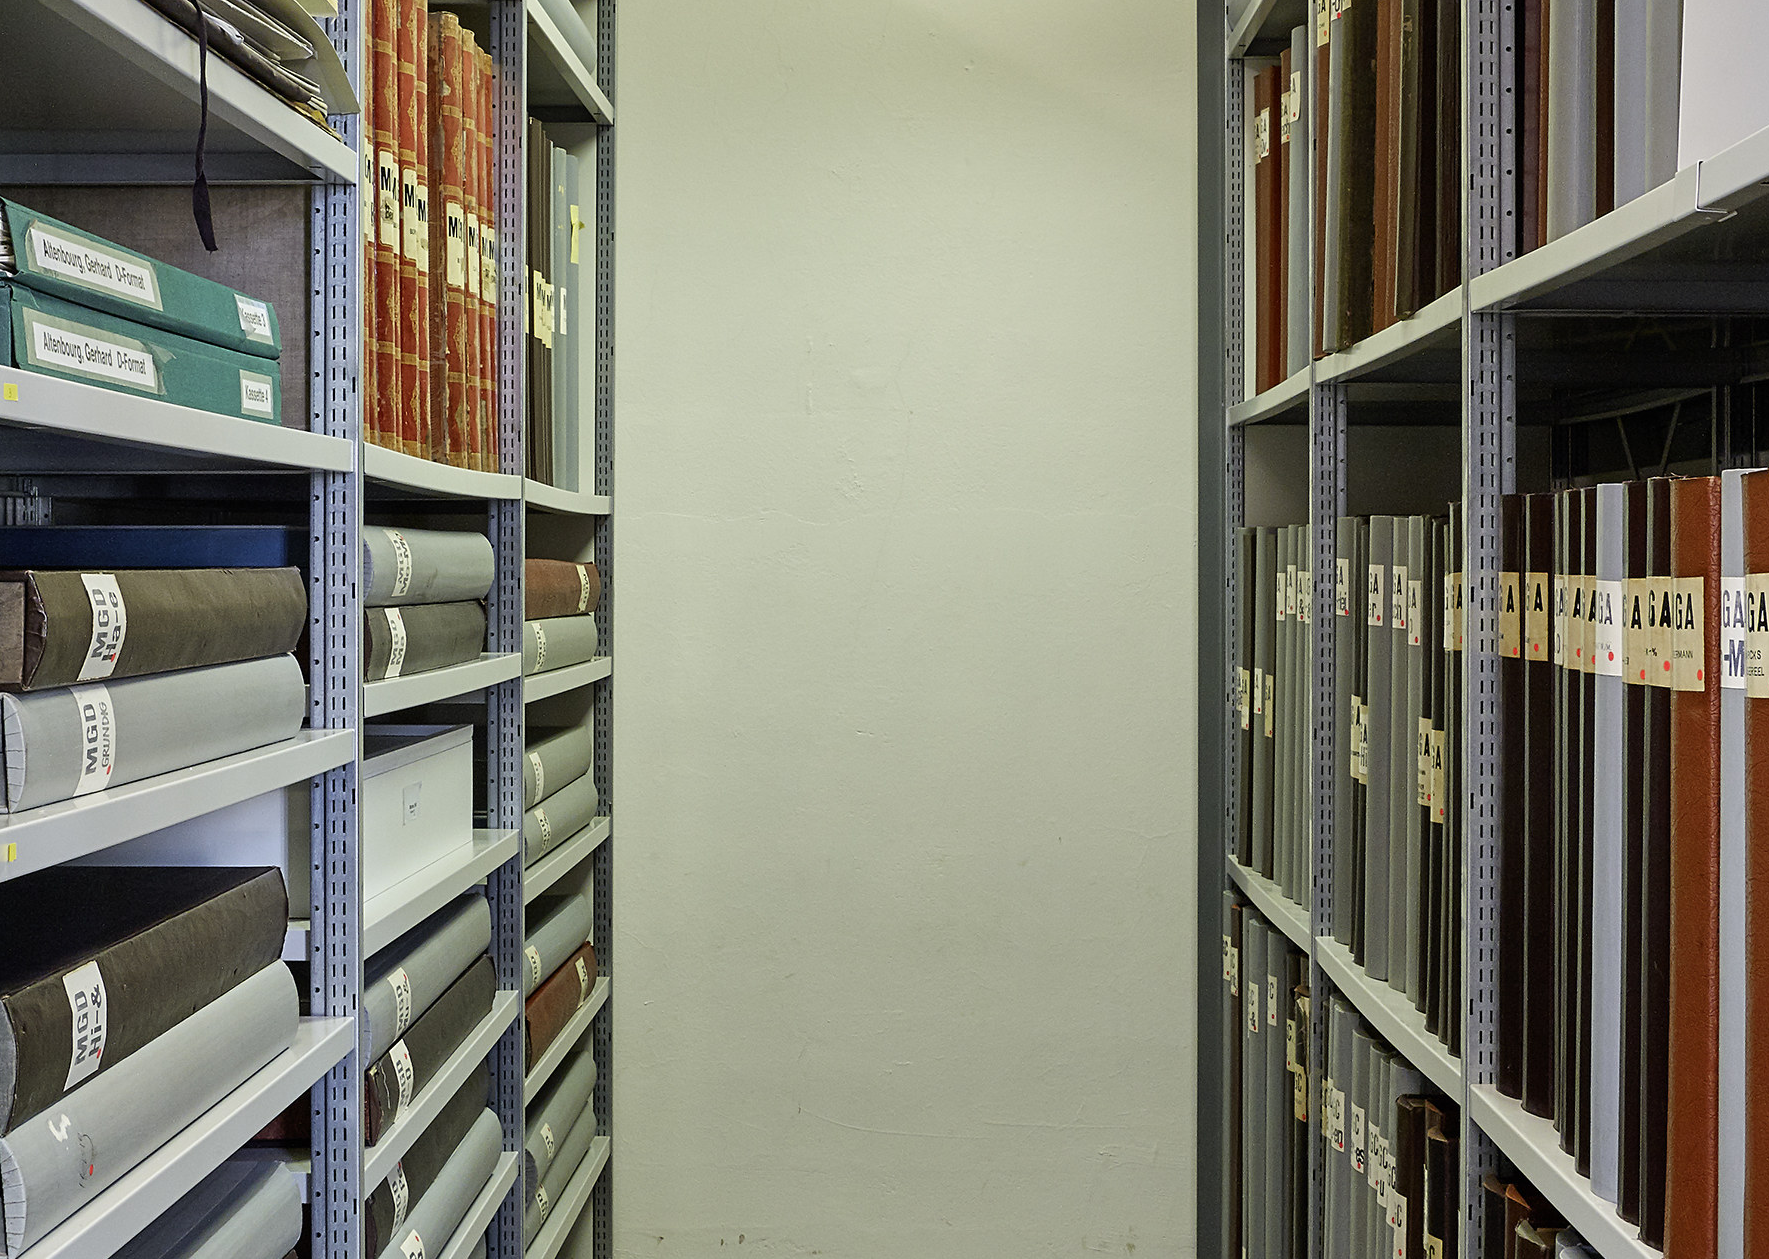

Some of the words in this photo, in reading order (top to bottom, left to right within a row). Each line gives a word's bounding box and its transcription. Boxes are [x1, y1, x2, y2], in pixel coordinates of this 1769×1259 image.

[43, 238, 85, 274] Altenbourg,
[85, 253, 112, 280] Gerhard
[115, 264, 146, 291] D-Format
[43, 331, 84, 365] Altenbourg,
[85, 342, 113, 367] Gerhard
[117, 351, 147, 376] D-Format
[91, 588, 110, 659] MGD
[1598, 591, 1613, 625] GA
[1622, 593, 1643, 631] GA
[1648, 589, 1672, 628] GA
[1672, 591, 1695, 631] GA
[1722, 589, 1745, 628] GA
[1746, 591, 1769, 633] GA
[84, 703, 99, 776] MGD
[99, 701, 111, 769] GRUNDIG
[74, 990, 89, 1066] MGD
